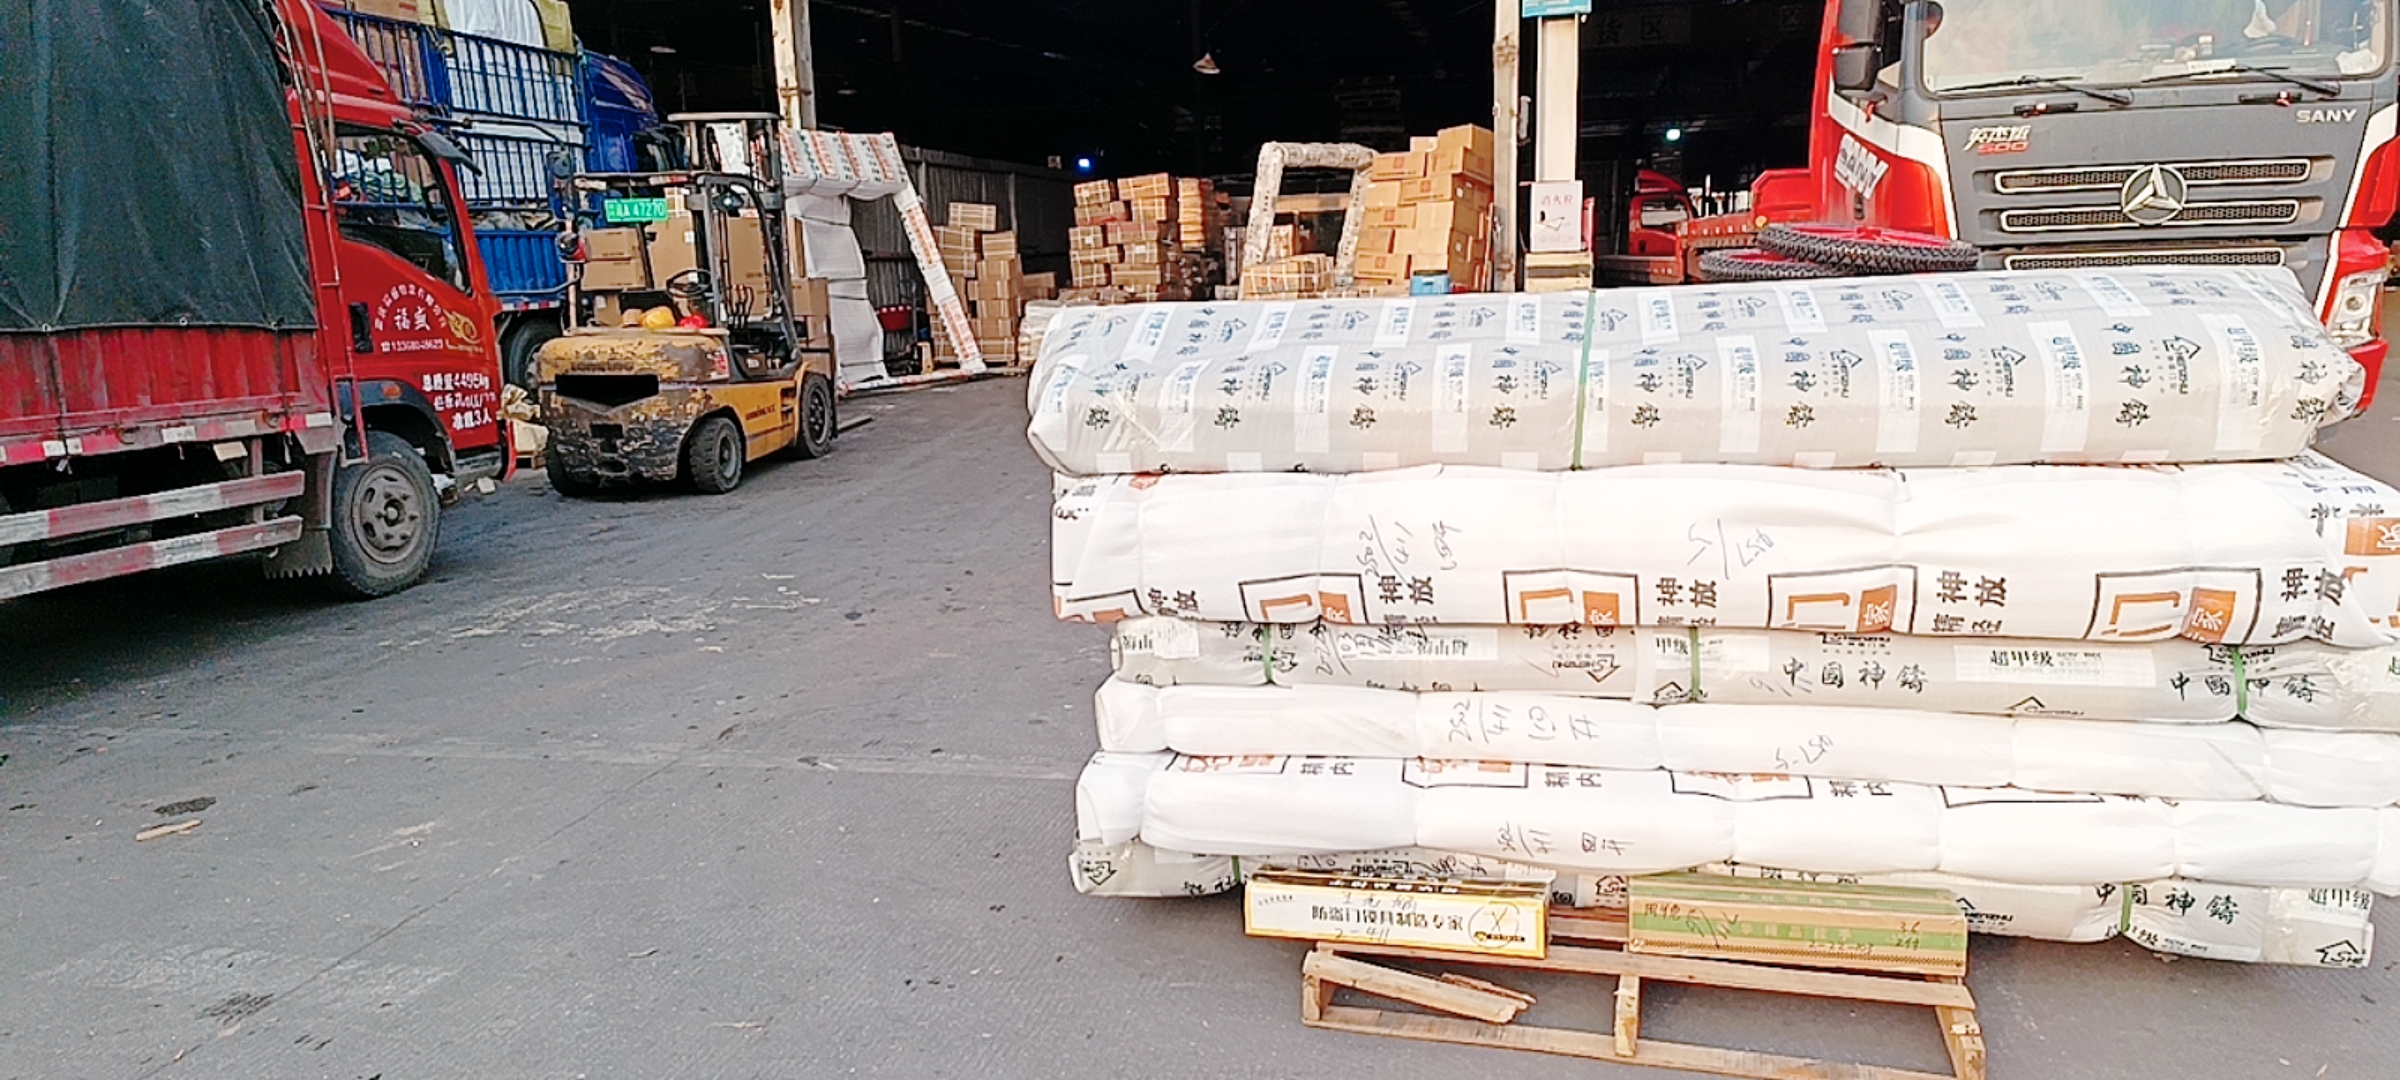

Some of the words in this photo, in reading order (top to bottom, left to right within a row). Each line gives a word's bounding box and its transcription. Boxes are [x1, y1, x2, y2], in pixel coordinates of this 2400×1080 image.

[2296, 110, 2357, 123] SANY
[1977, 141, 2030, 155] 500
[1989, 649, 2055, 668] 超甲级
[2308, 888, 2371, 911] 超甲级
